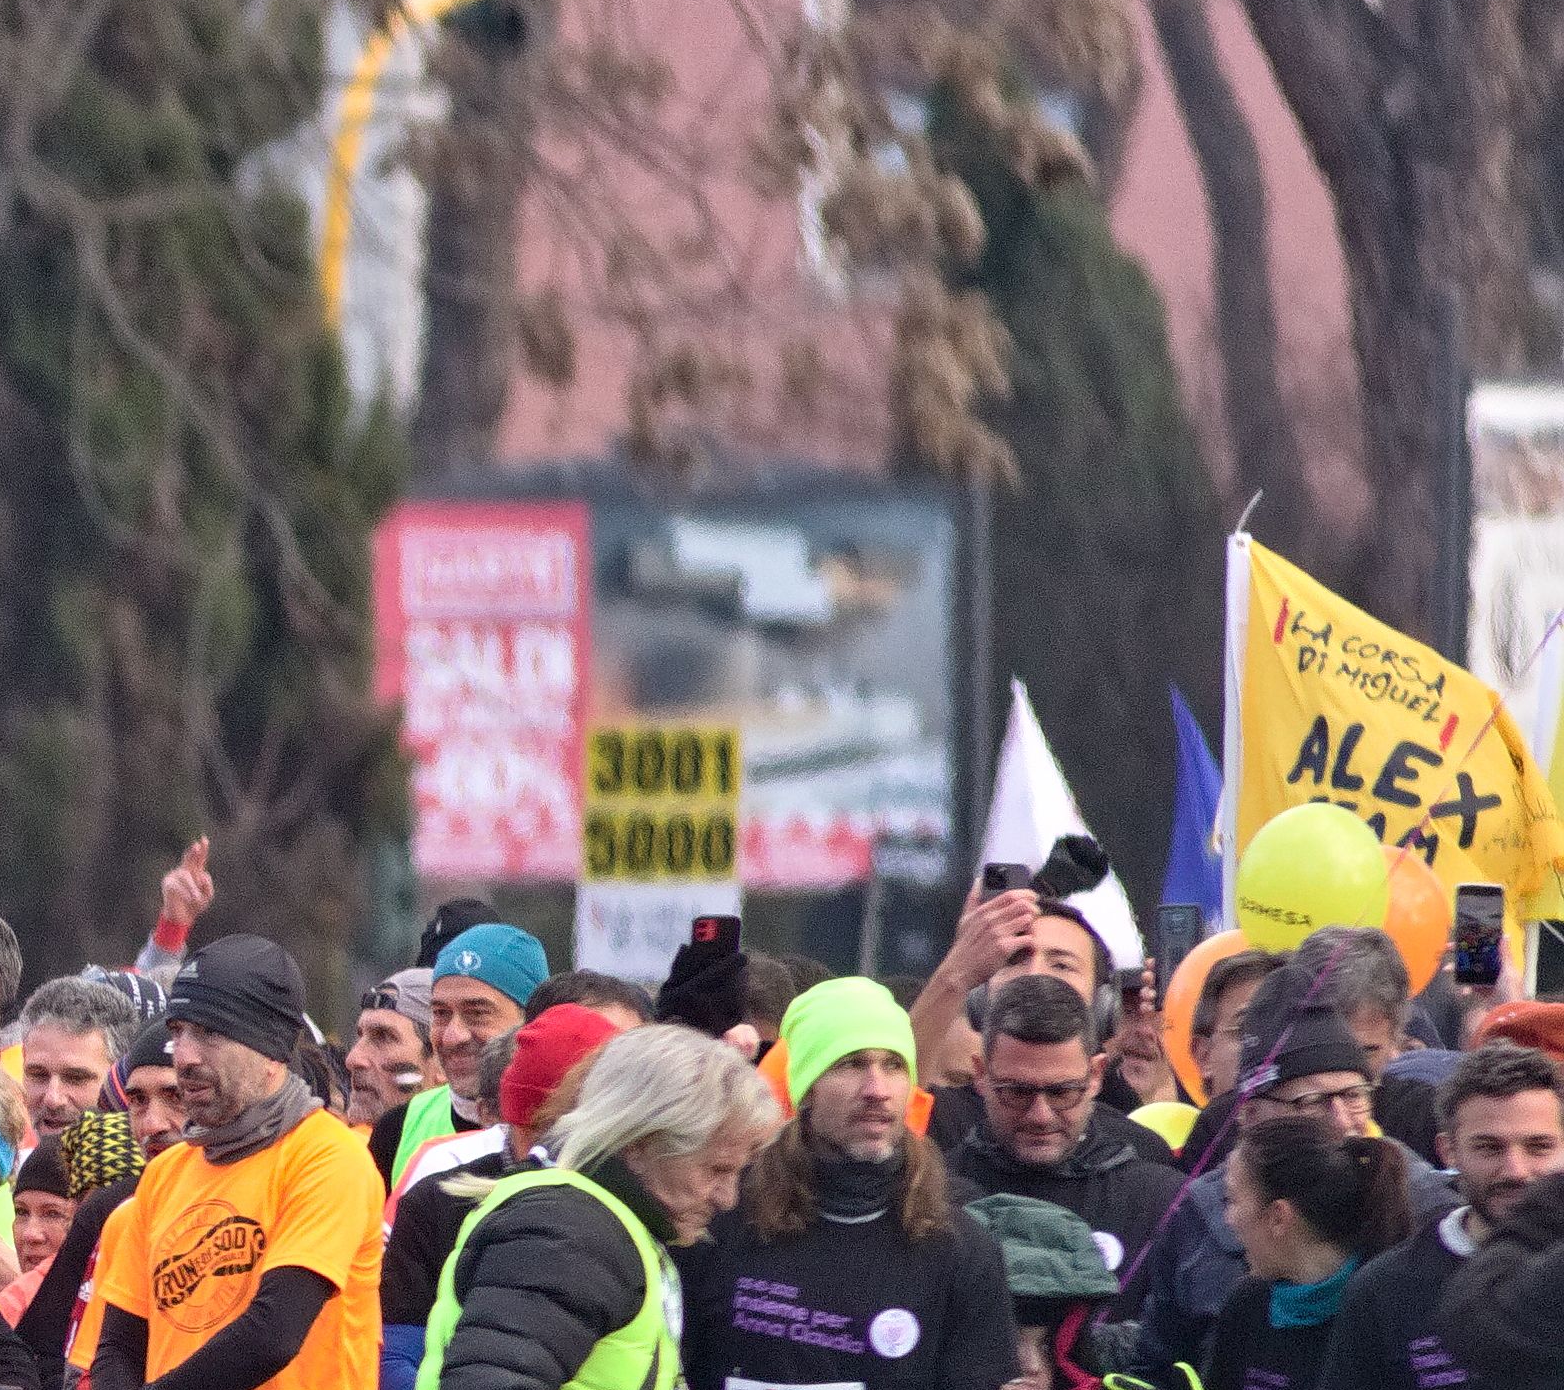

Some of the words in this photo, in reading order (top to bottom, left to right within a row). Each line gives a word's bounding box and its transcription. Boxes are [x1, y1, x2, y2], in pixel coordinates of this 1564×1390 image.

[1341, 635, 1447, 699] CORSA
[595, 730, 735, 796] 3001
[1286, 713, 1503, 850] ALEX
[586, 811, 737, 875] 5000
